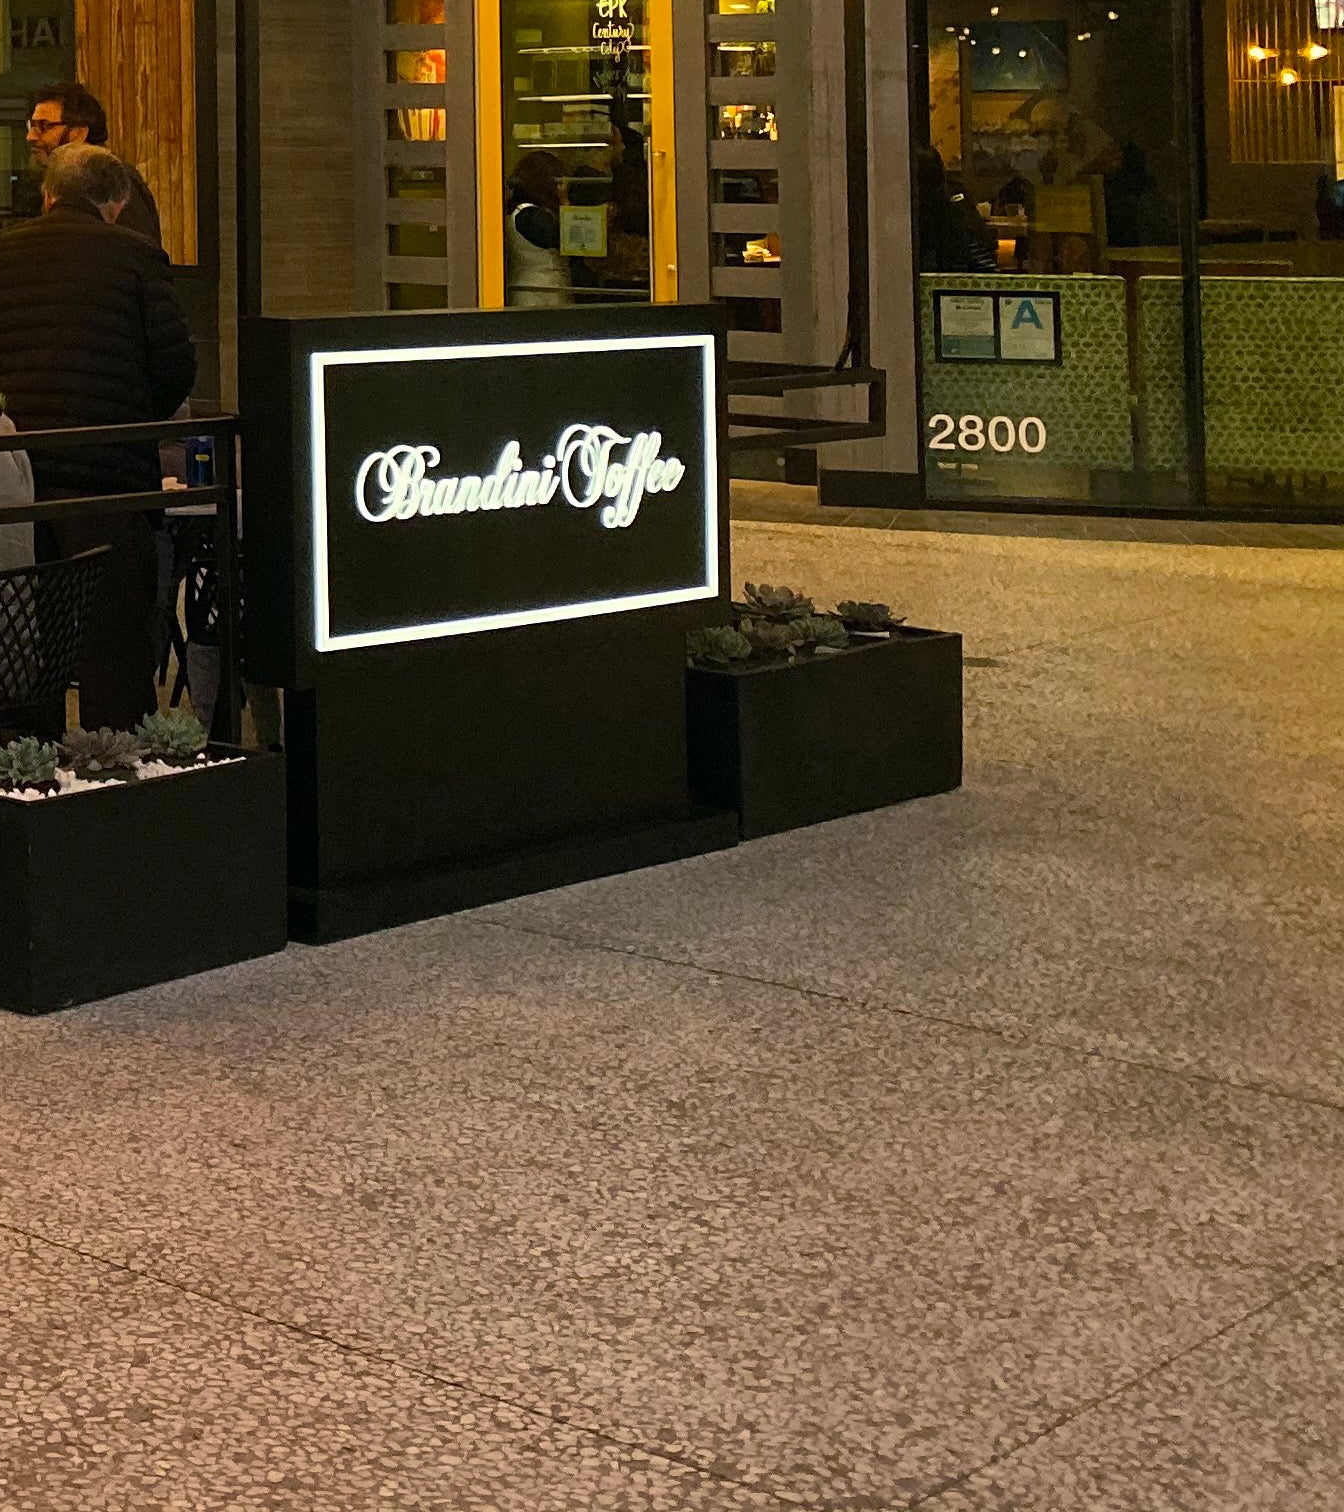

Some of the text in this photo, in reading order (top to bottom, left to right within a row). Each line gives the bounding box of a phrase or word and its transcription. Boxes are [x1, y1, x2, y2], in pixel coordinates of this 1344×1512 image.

[592, 20, 634, 40] Century
[1011, 299, 1044, 330] A
[928, 414, 1047, 454] 2800
[356, 424, 686, 529] Brandini Toffee
